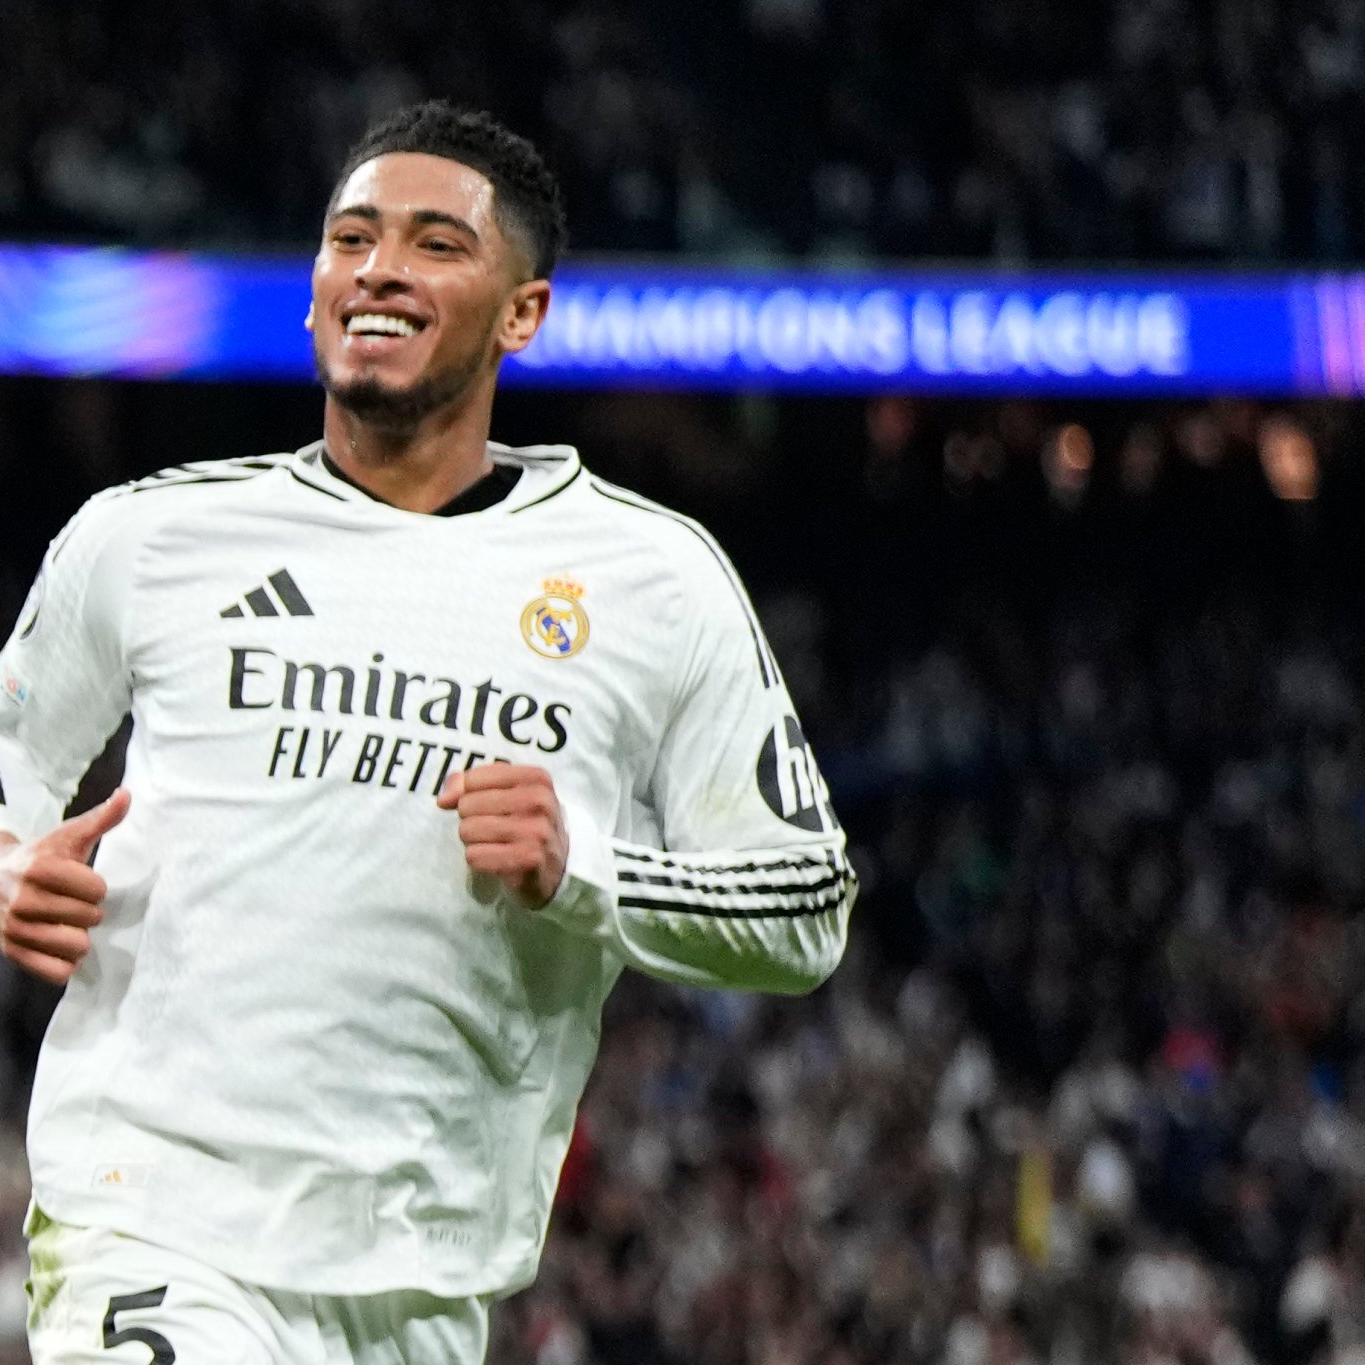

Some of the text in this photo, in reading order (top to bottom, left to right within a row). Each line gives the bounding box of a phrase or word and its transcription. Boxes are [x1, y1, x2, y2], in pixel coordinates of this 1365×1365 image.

[228, 645, 573, 754] Emirates
[268, 726, 513, 797] FLY BETT
